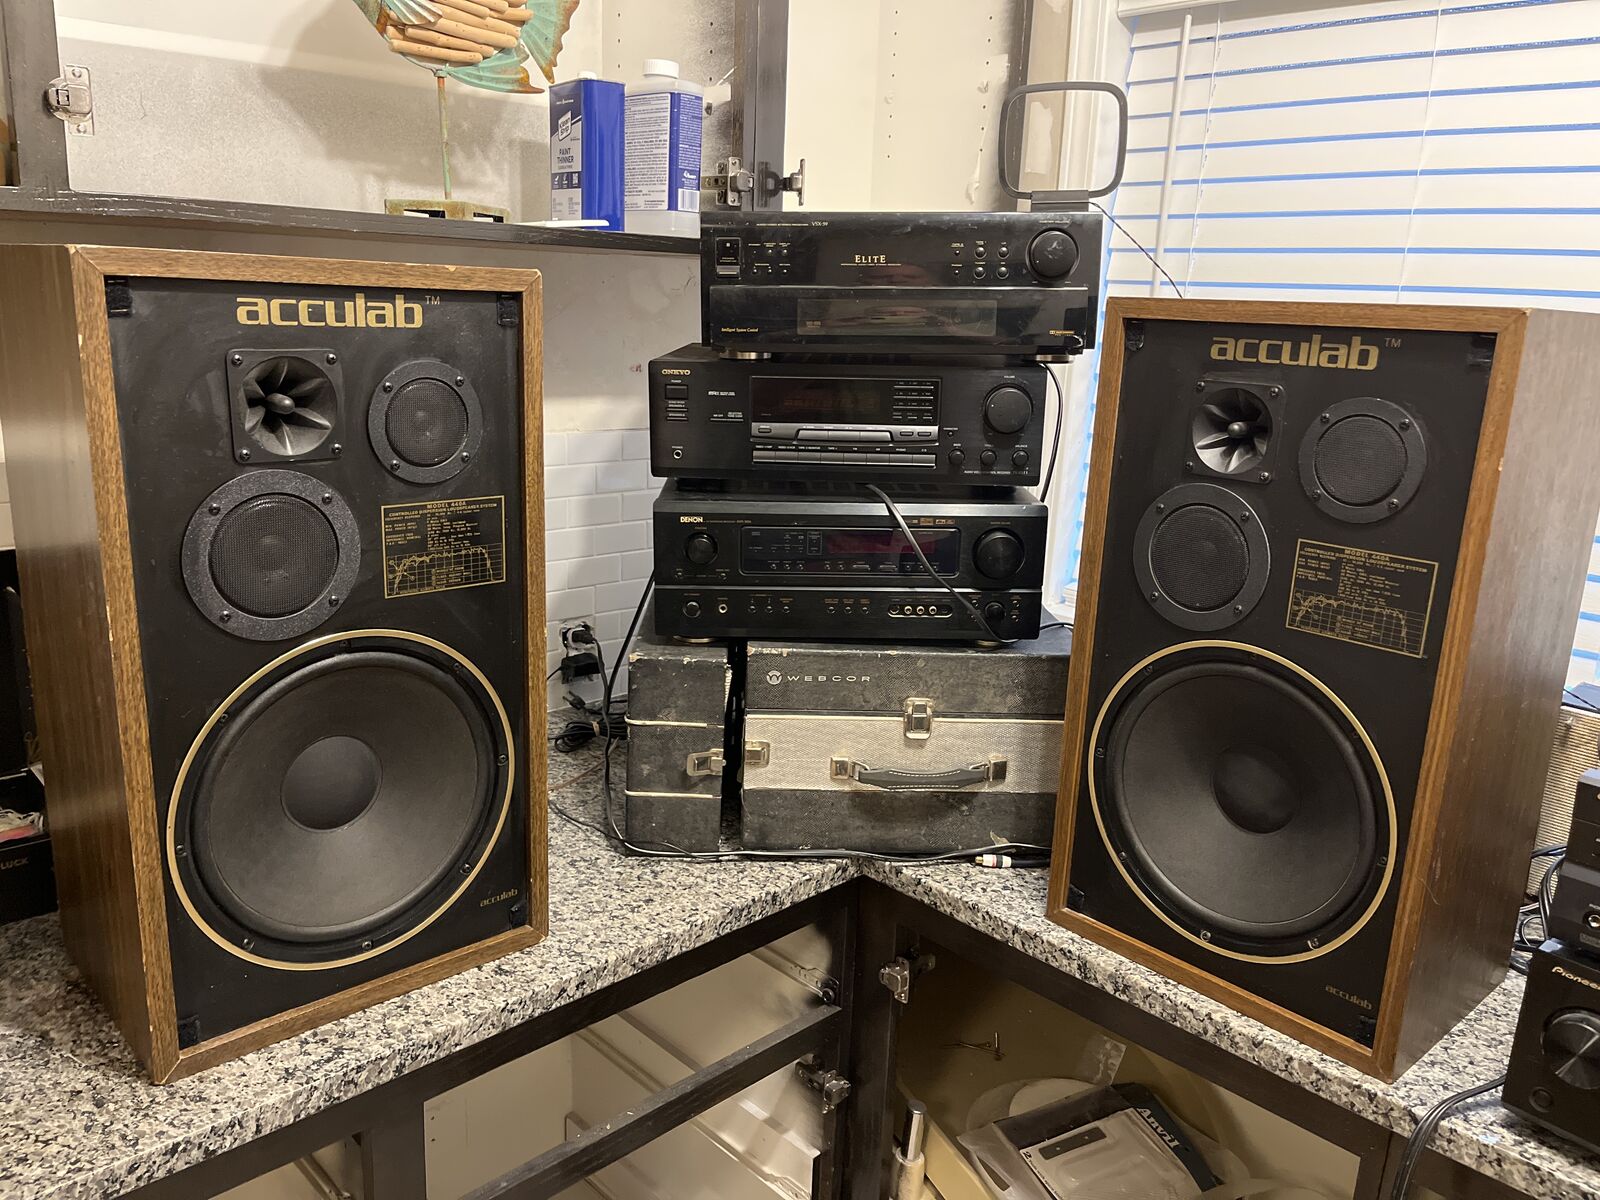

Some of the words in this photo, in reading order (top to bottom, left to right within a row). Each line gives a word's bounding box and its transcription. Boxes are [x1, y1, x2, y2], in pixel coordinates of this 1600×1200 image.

[557, 155, 574, 164] THINNER
[559, 147, 571, 155] PAINT
[855, 254, 886, 263] ELITE
[236, 293, 423, 328] acculab
[1210, 334, 1379, 371] acculab
[1344, 549, 1368, 558] MODEL
[480, 888, 518, 907] acculab
[1325, 984, 1372, 1010] acculab
[1135, 1108, 1180, 1148] Anvil
